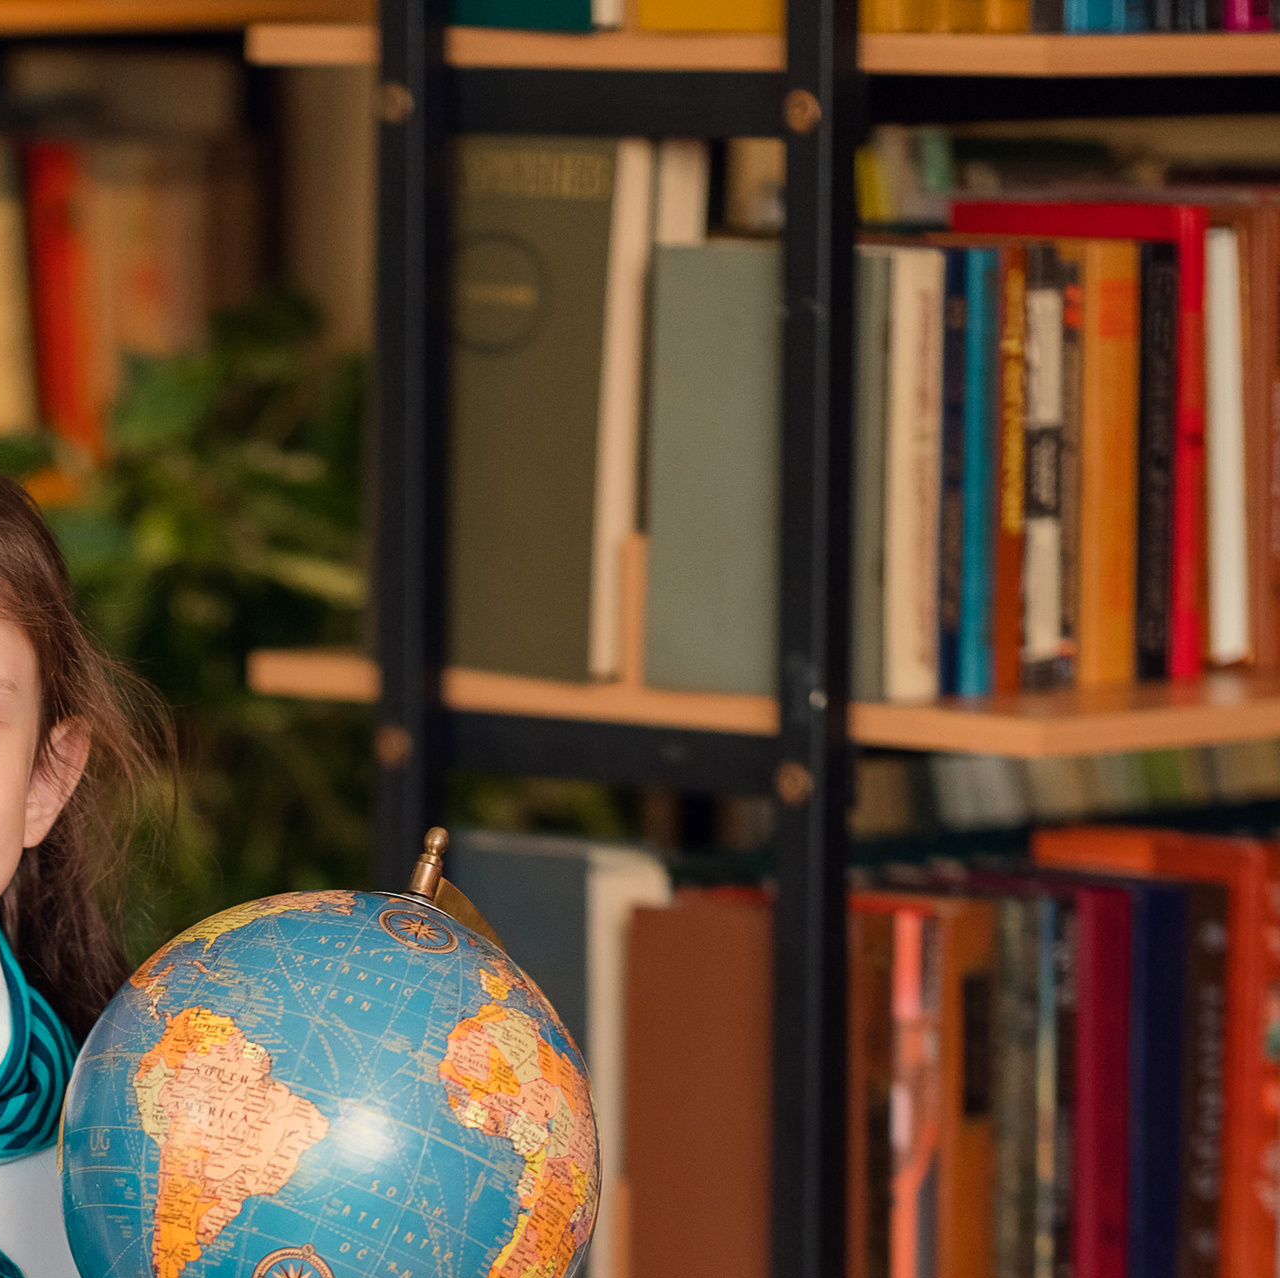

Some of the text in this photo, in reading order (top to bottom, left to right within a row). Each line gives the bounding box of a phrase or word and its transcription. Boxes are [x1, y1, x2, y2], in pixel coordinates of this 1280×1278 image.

[318, 935, 393, 963] NORTH
[294, 954, 415, 998] ATLANTIC
[293, 980, 372, 1012] OCEAN
[195, 1067, 249, 1084] SOUTH
[174, 1101, 249, 1123] AMERICA
